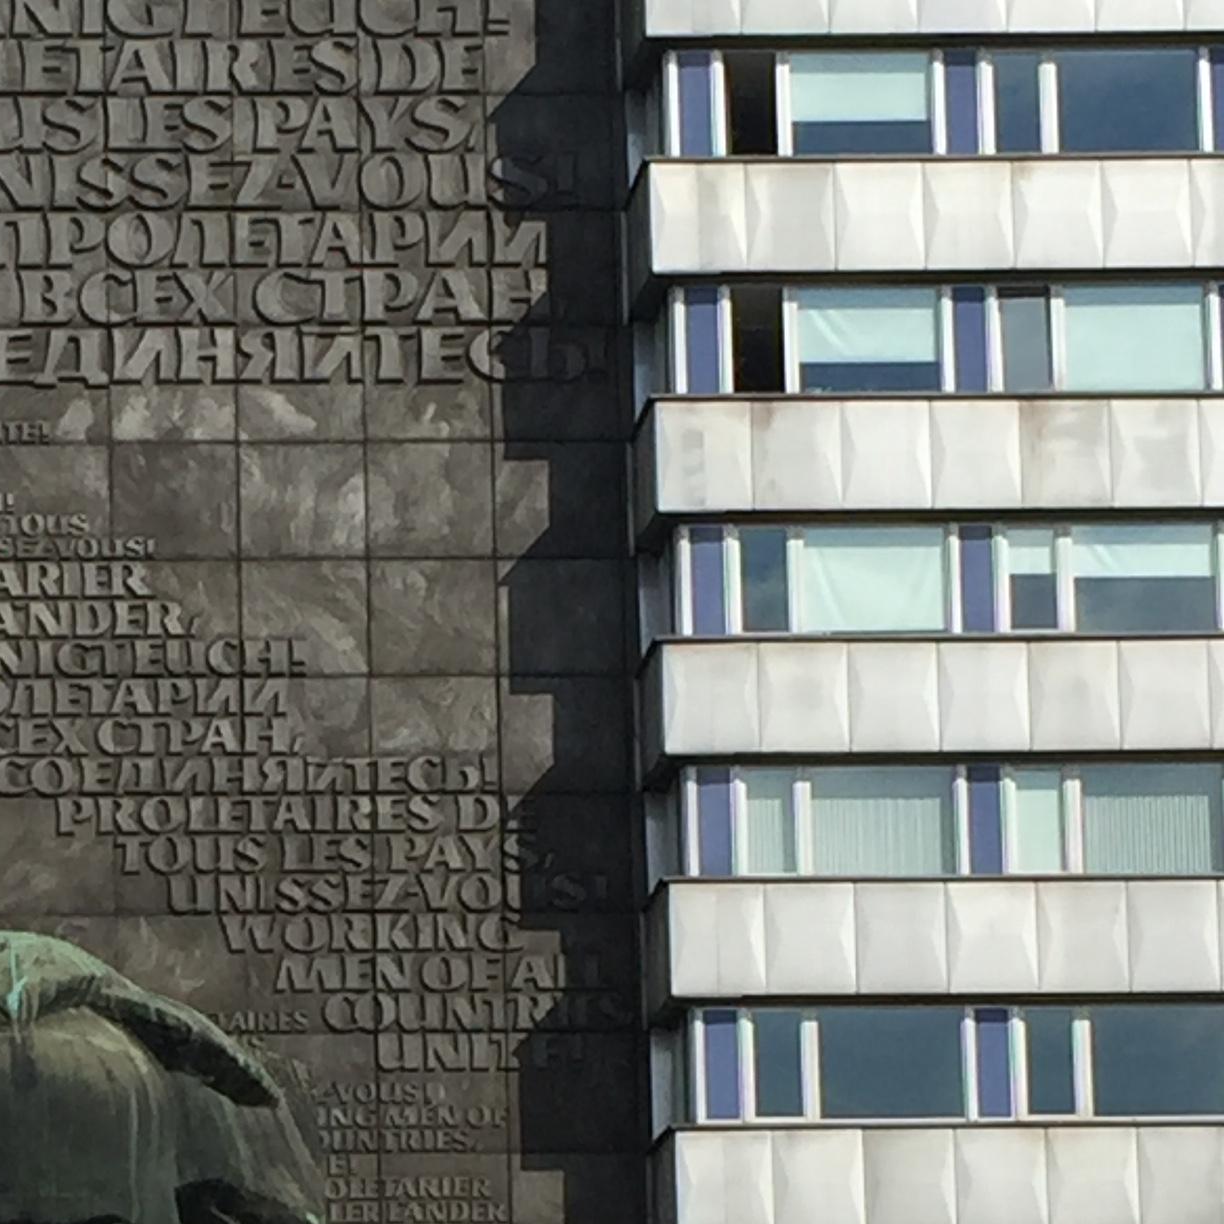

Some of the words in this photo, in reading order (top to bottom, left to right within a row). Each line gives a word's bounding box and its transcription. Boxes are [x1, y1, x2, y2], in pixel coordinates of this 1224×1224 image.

[374, 41, 483, 95] DE
[103, 98, 231, 153] LES
[17, 270, 235, 326] ВСЕХ
[132, 640, 306, 679] EUCH!
[56, 794, 444, 835] PROLETAIRES
[119, 836, 268, 874] TOUS
[281, 836, 370, 874] LES
[218, 914, 527, 953] WORKING
[276, 953, 408, 993] MEN
[422, 953, 503, 993] OF
